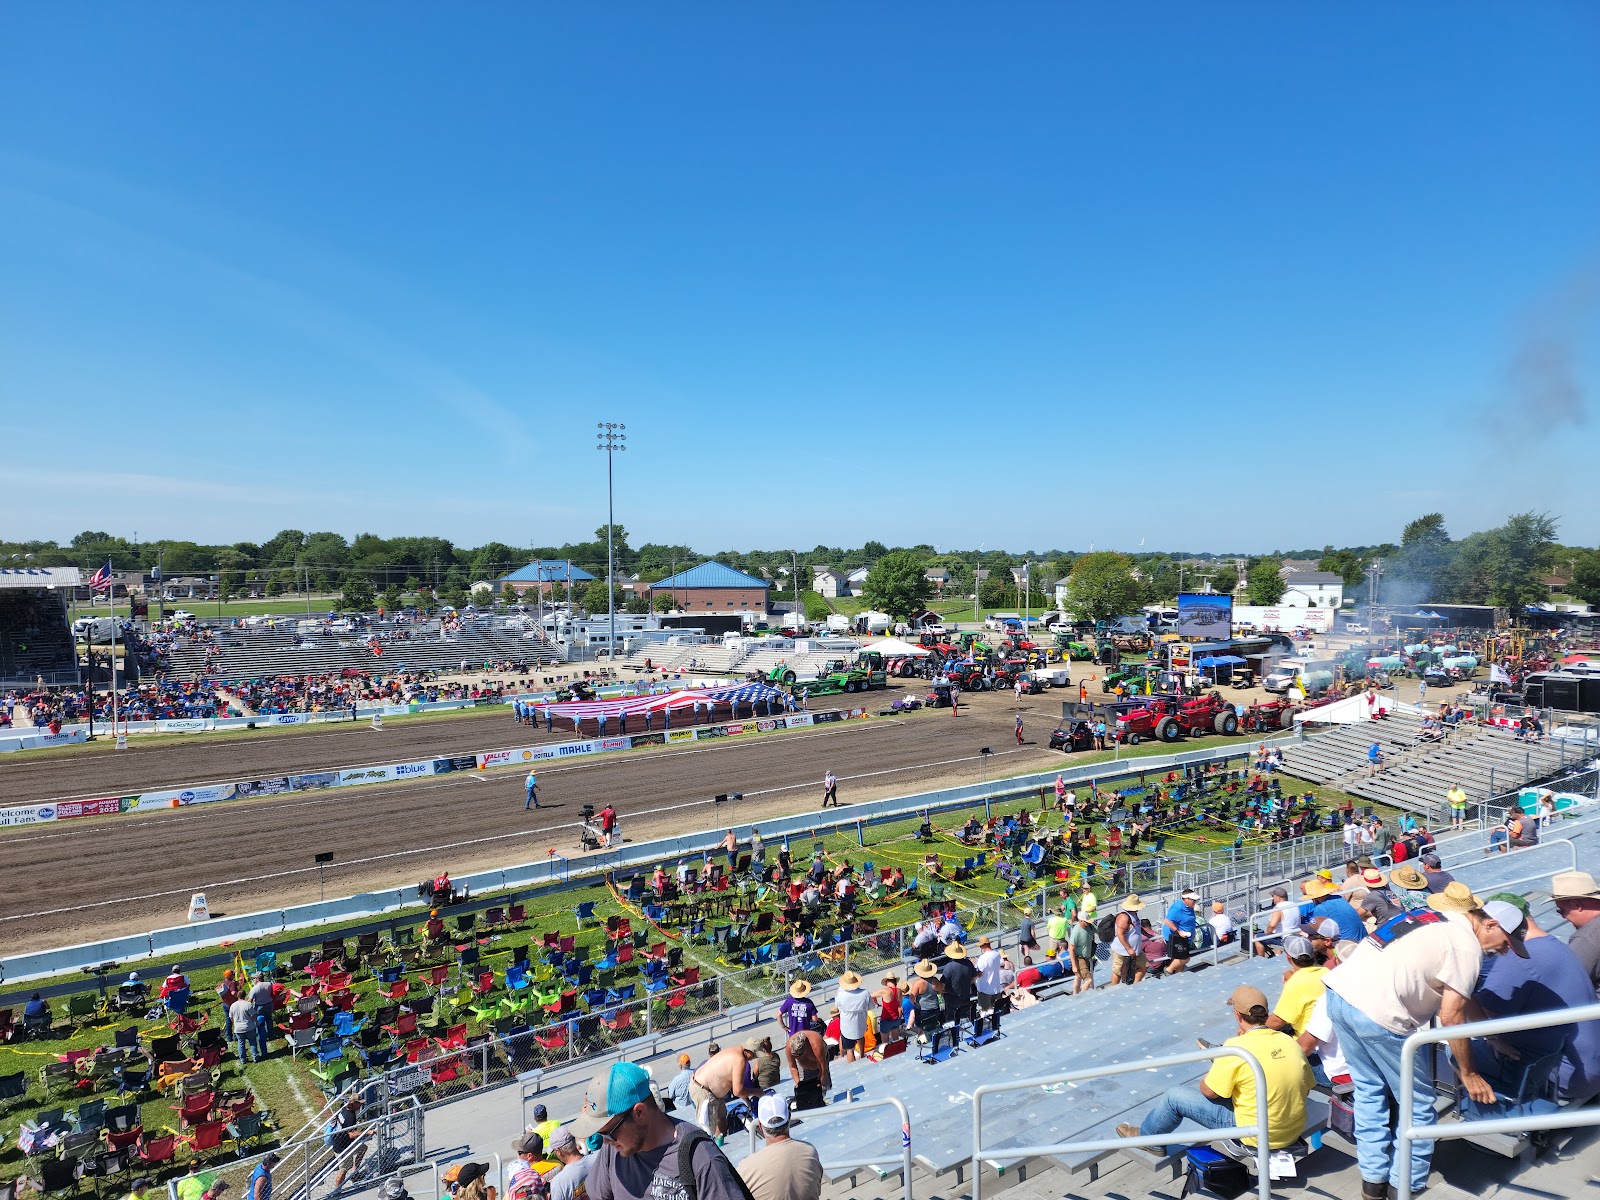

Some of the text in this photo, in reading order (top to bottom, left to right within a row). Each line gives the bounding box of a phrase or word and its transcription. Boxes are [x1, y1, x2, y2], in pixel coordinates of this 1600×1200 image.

[602, 740, 623, 748] SUMMIT
[559, 745, 592, 755] MAHLE
[483, 752, 511, 763] VALLEY
[534, 752, 554, 760] ROTELLA
[405, 764, 426, 773] blue
[410, 1071, 430, 1080] SEATING
[402, 1077, 428, 1089] RESERVED
[653, 1176, 684, 1189] HAISL
